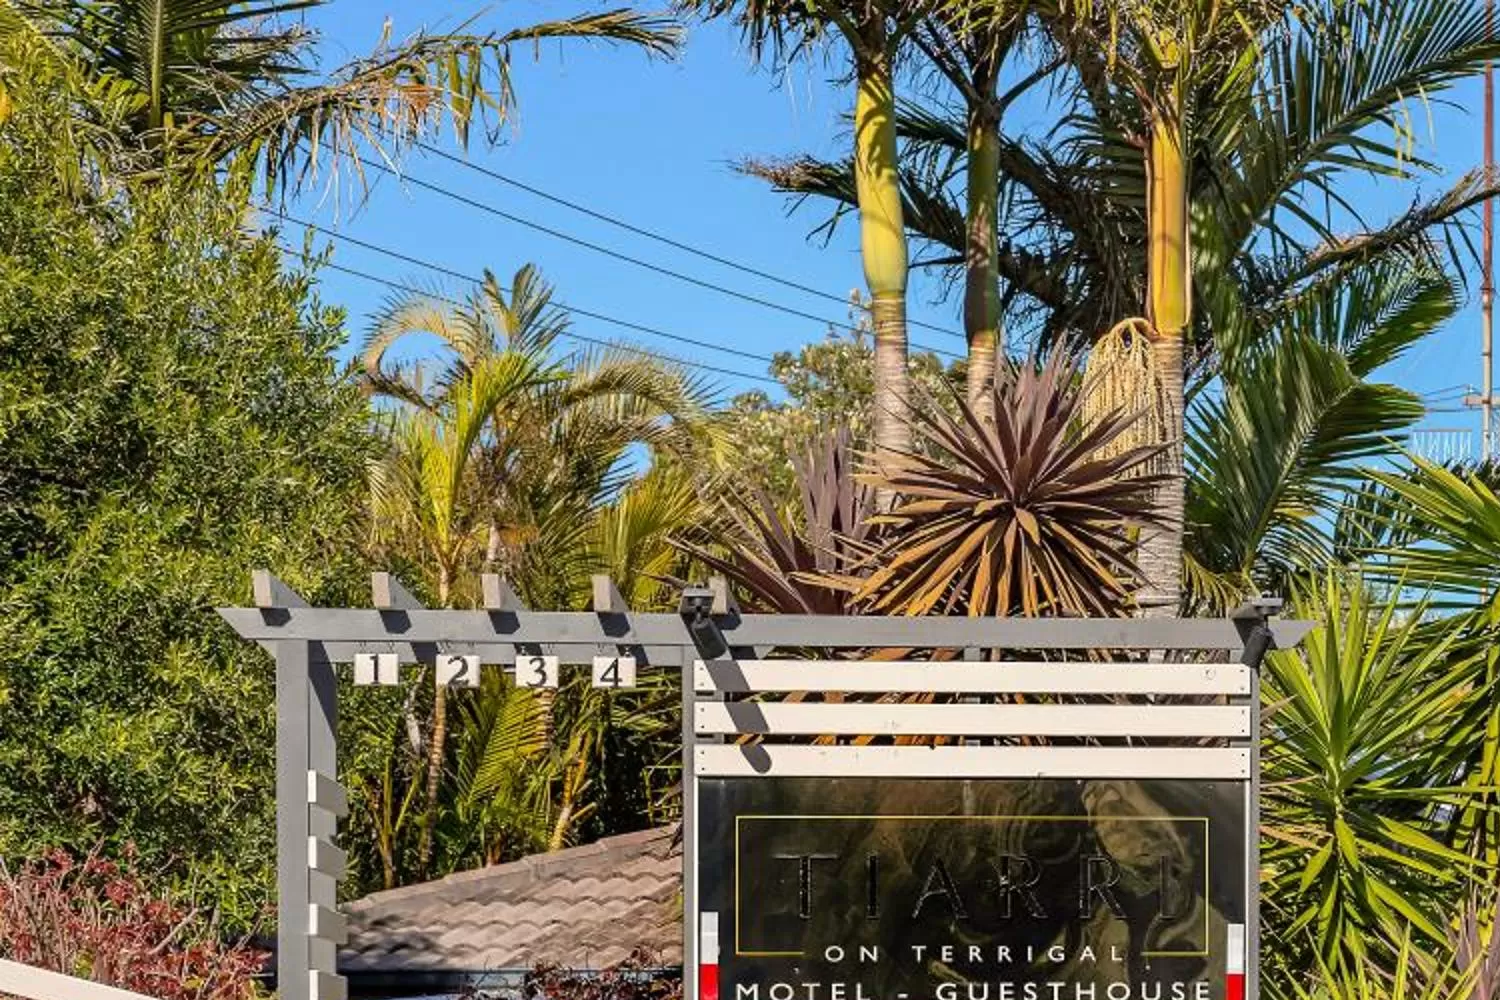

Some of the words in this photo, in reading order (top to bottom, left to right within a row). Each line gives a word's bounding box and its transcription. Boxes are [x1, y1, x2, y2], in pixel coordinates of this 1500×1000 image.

[369, 654, 380, 684] 1
[448, 656, 469, 686] 2
[526, 657, 547, 686] 3
[599, 658, 622, 687] 4
[774, 853, 1178, 919] TIARRI
[824, 944, 879, 963] ON
[912, 944, 1125, 963] TERRIGAL
